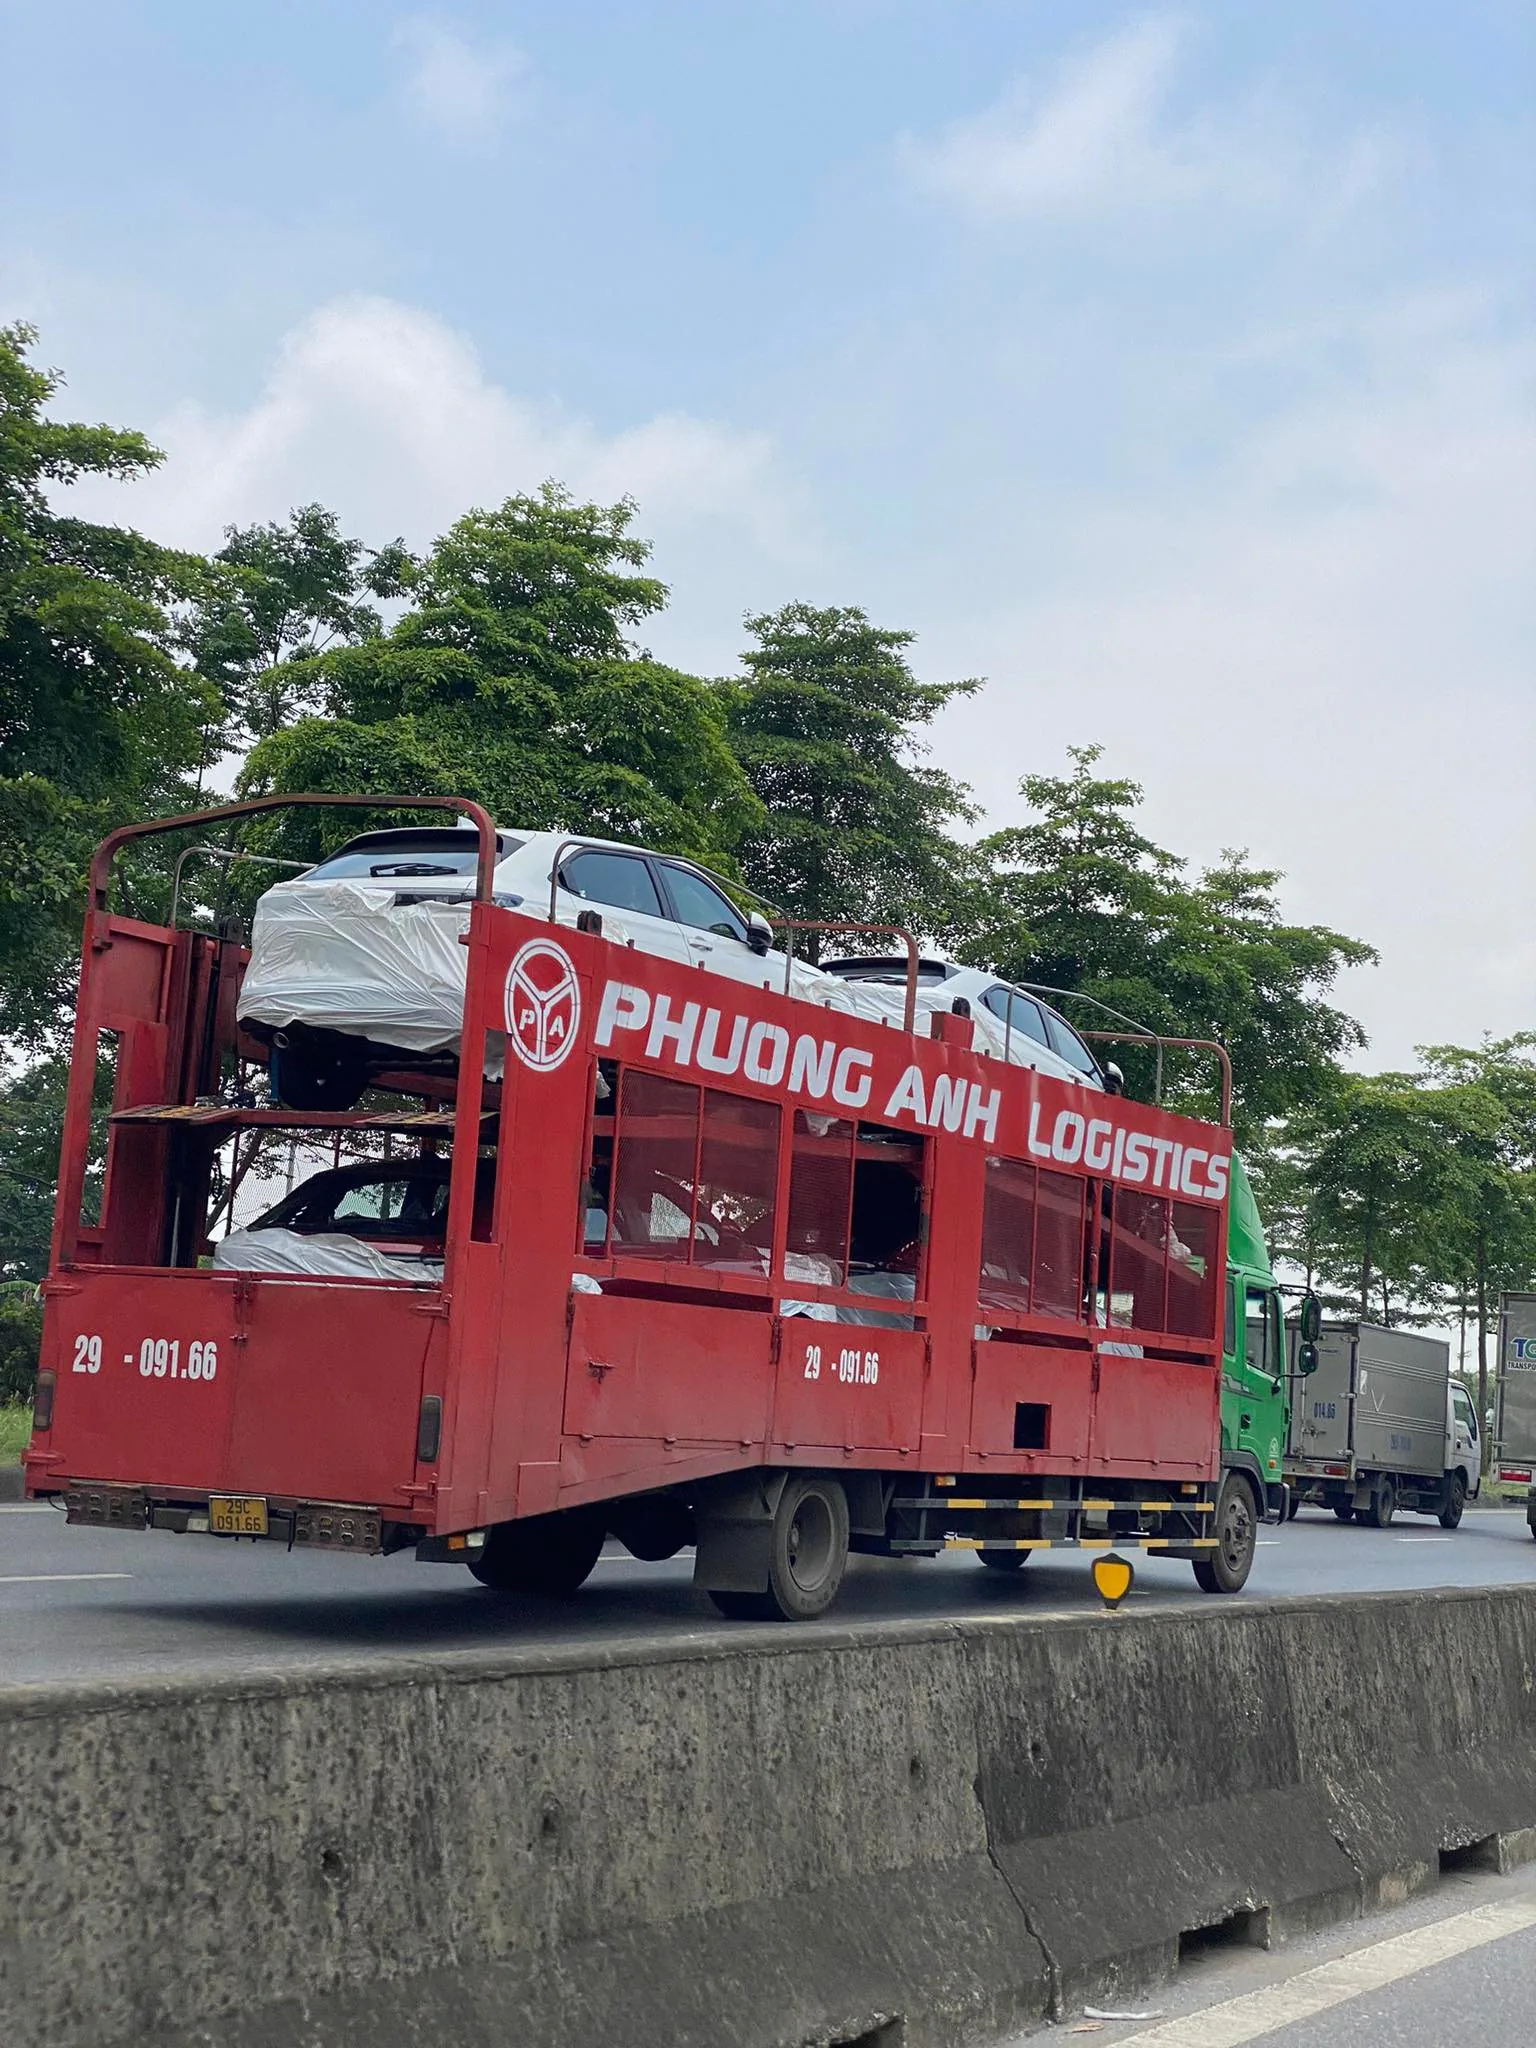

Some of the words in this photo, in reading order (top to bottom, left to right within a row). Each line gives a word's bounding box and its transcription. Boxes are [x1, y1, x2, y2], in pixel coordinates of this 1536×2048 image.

[519, 1008, 536, 1031] P
[548, 1015, 565, 1038] A
[594, 979, 874, 1108] PHUONG
[884, 1065, 1001, 1143] ANH
[1028, 1102, 1230, 1200] LOGISTICS
[72, 1334, 102, 1374] 29
[804, 1345, 821, 1379] 29
[226, 1499, 250, 1514] 29C
[217, 1515, 261, 1531] 091.66
